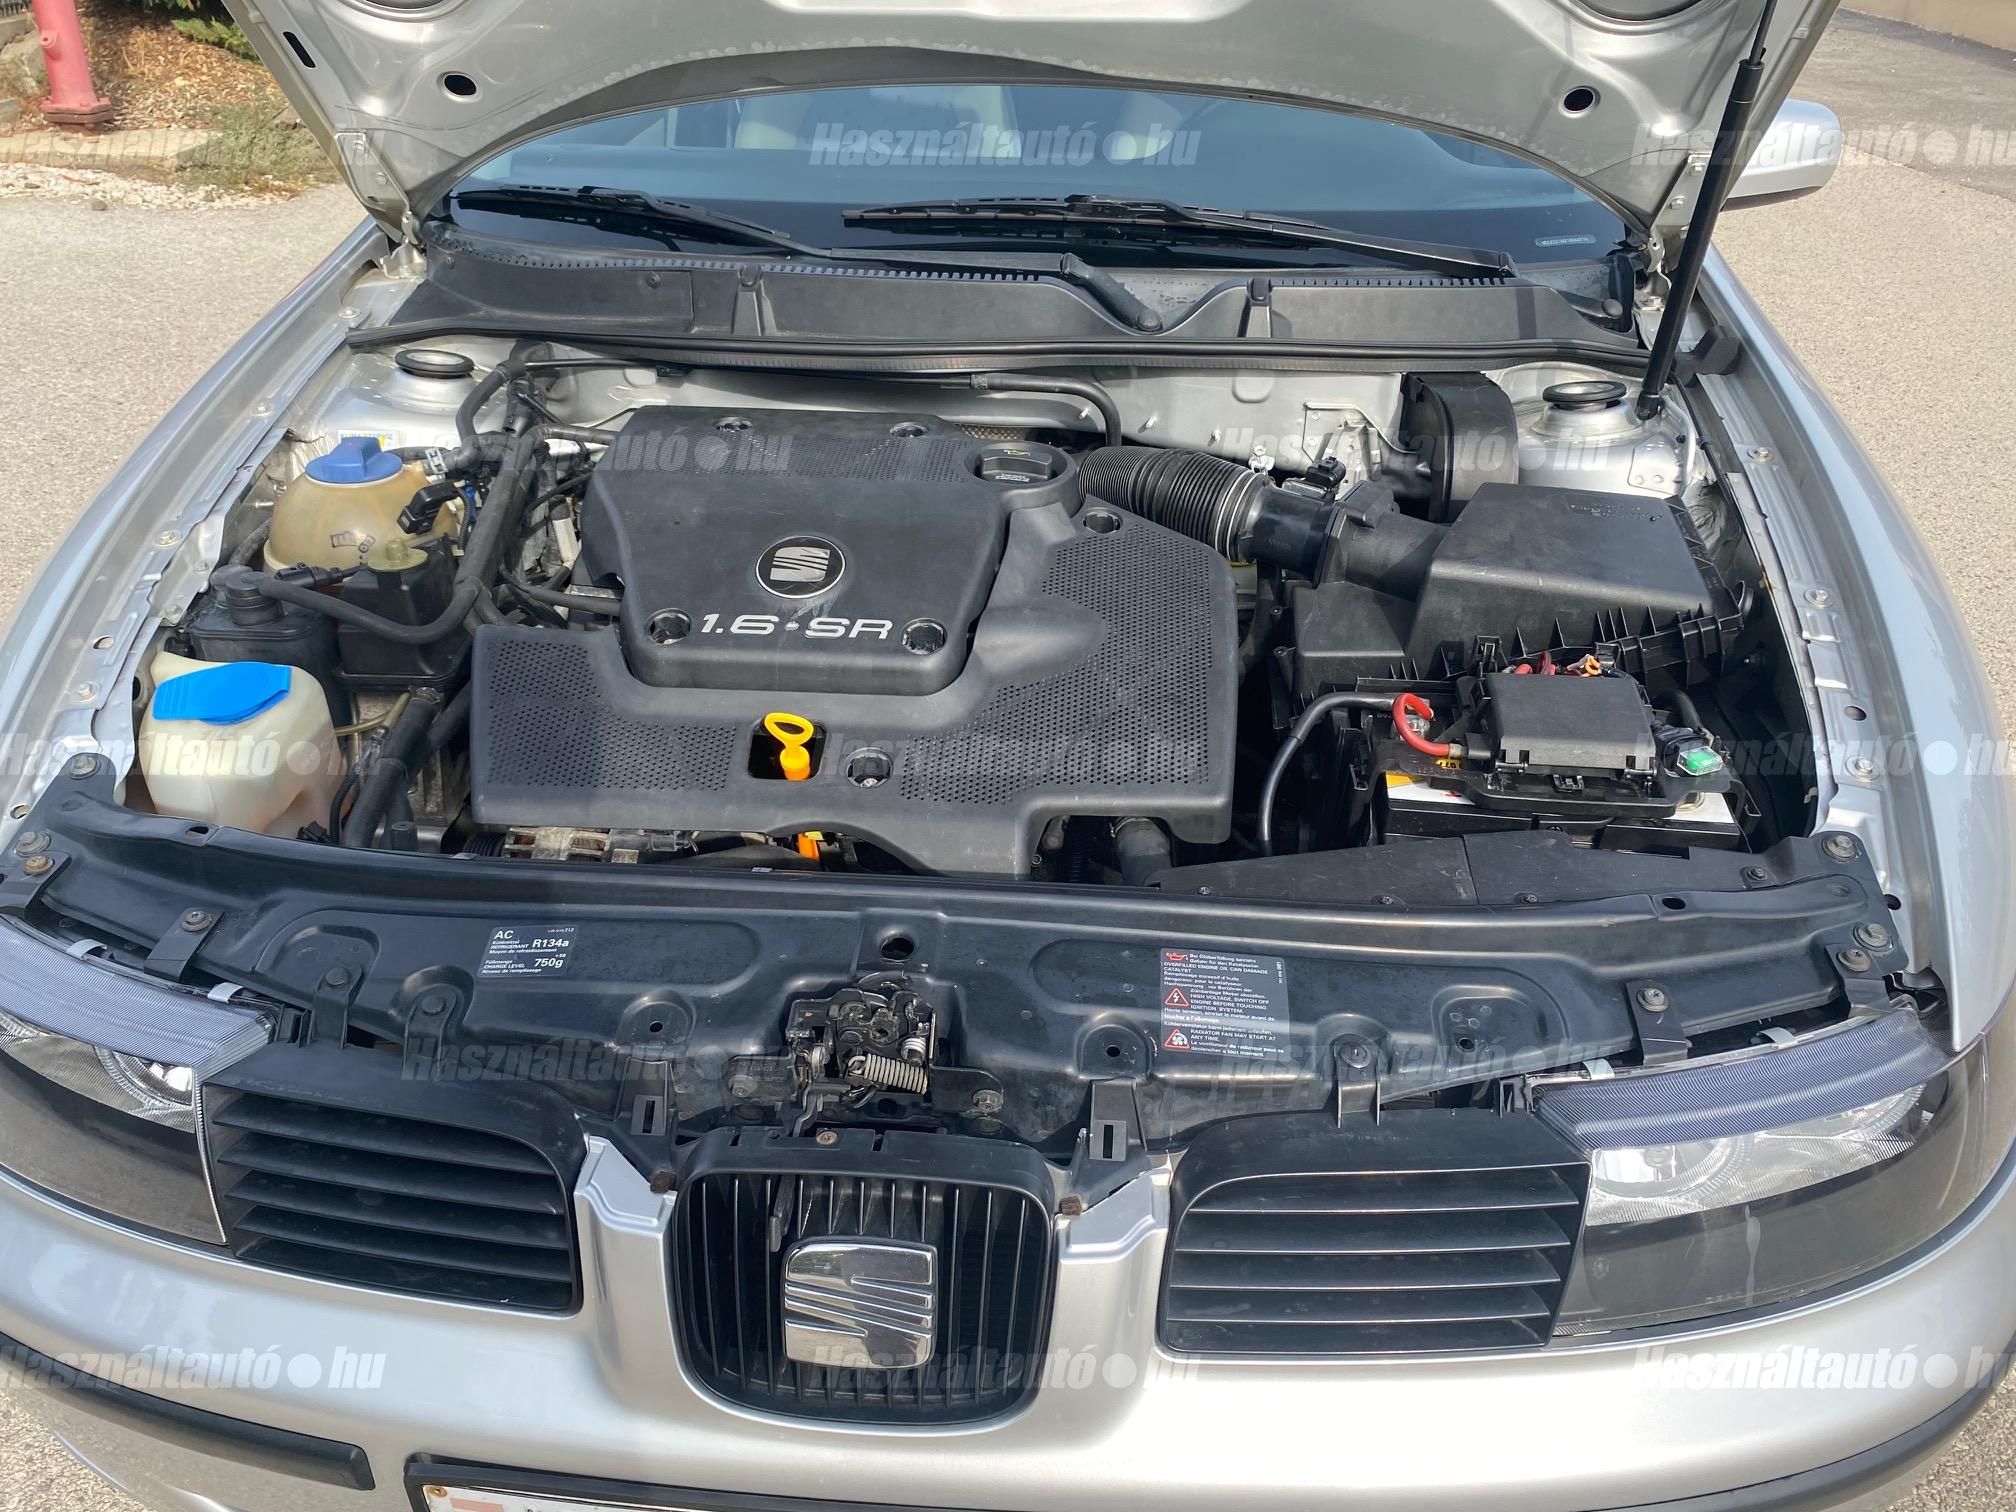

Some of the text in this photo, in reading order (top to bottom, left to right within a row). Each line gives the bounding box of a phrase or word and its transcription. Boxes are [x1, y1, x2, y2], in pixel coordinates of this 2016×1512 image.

[493, 930, 514, 940] AC
[532, 938, 570, 948] R134a
[534, 957, 564, 969] 750g
[1164, 961, 1197, 969] OVERFILLED
[1236, 1002, 1267, 1010] TOUCHING
